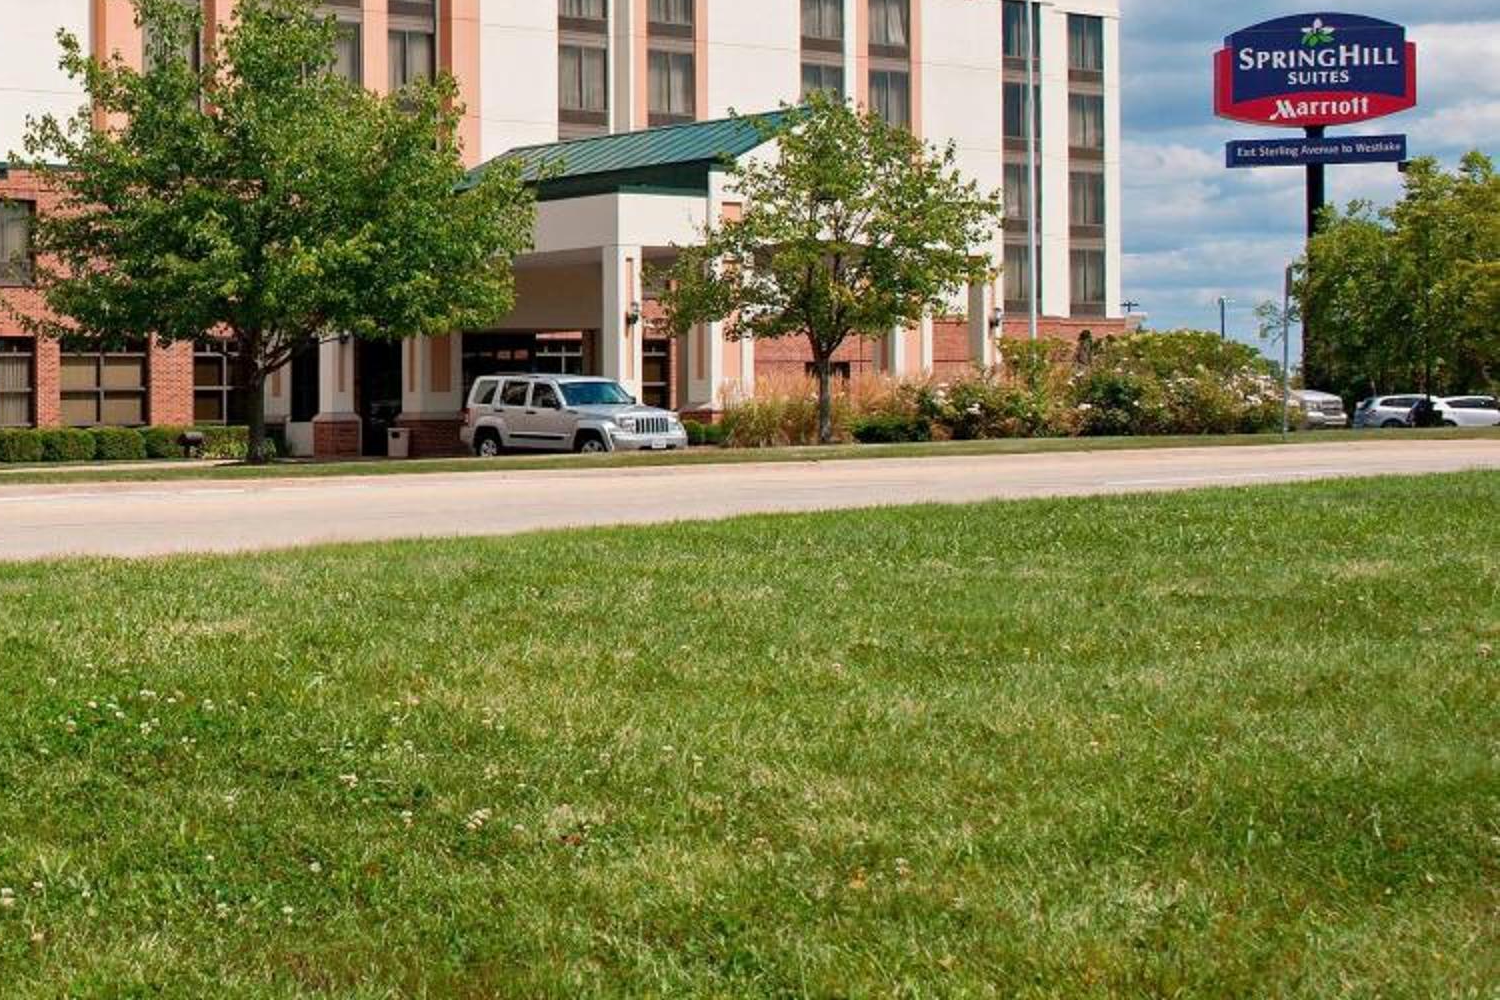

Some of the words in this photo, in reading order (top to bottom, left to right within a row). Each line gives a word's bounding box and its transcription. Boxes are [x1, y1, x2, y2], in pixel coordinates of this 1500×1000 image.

[1239, 44, 1399, 70] SPRINGHILL
[1287, 70, 1350, 85] SUITES
[1269, 97, 1369, 120] Marriott
[1341, 143, 1353, 153] to
